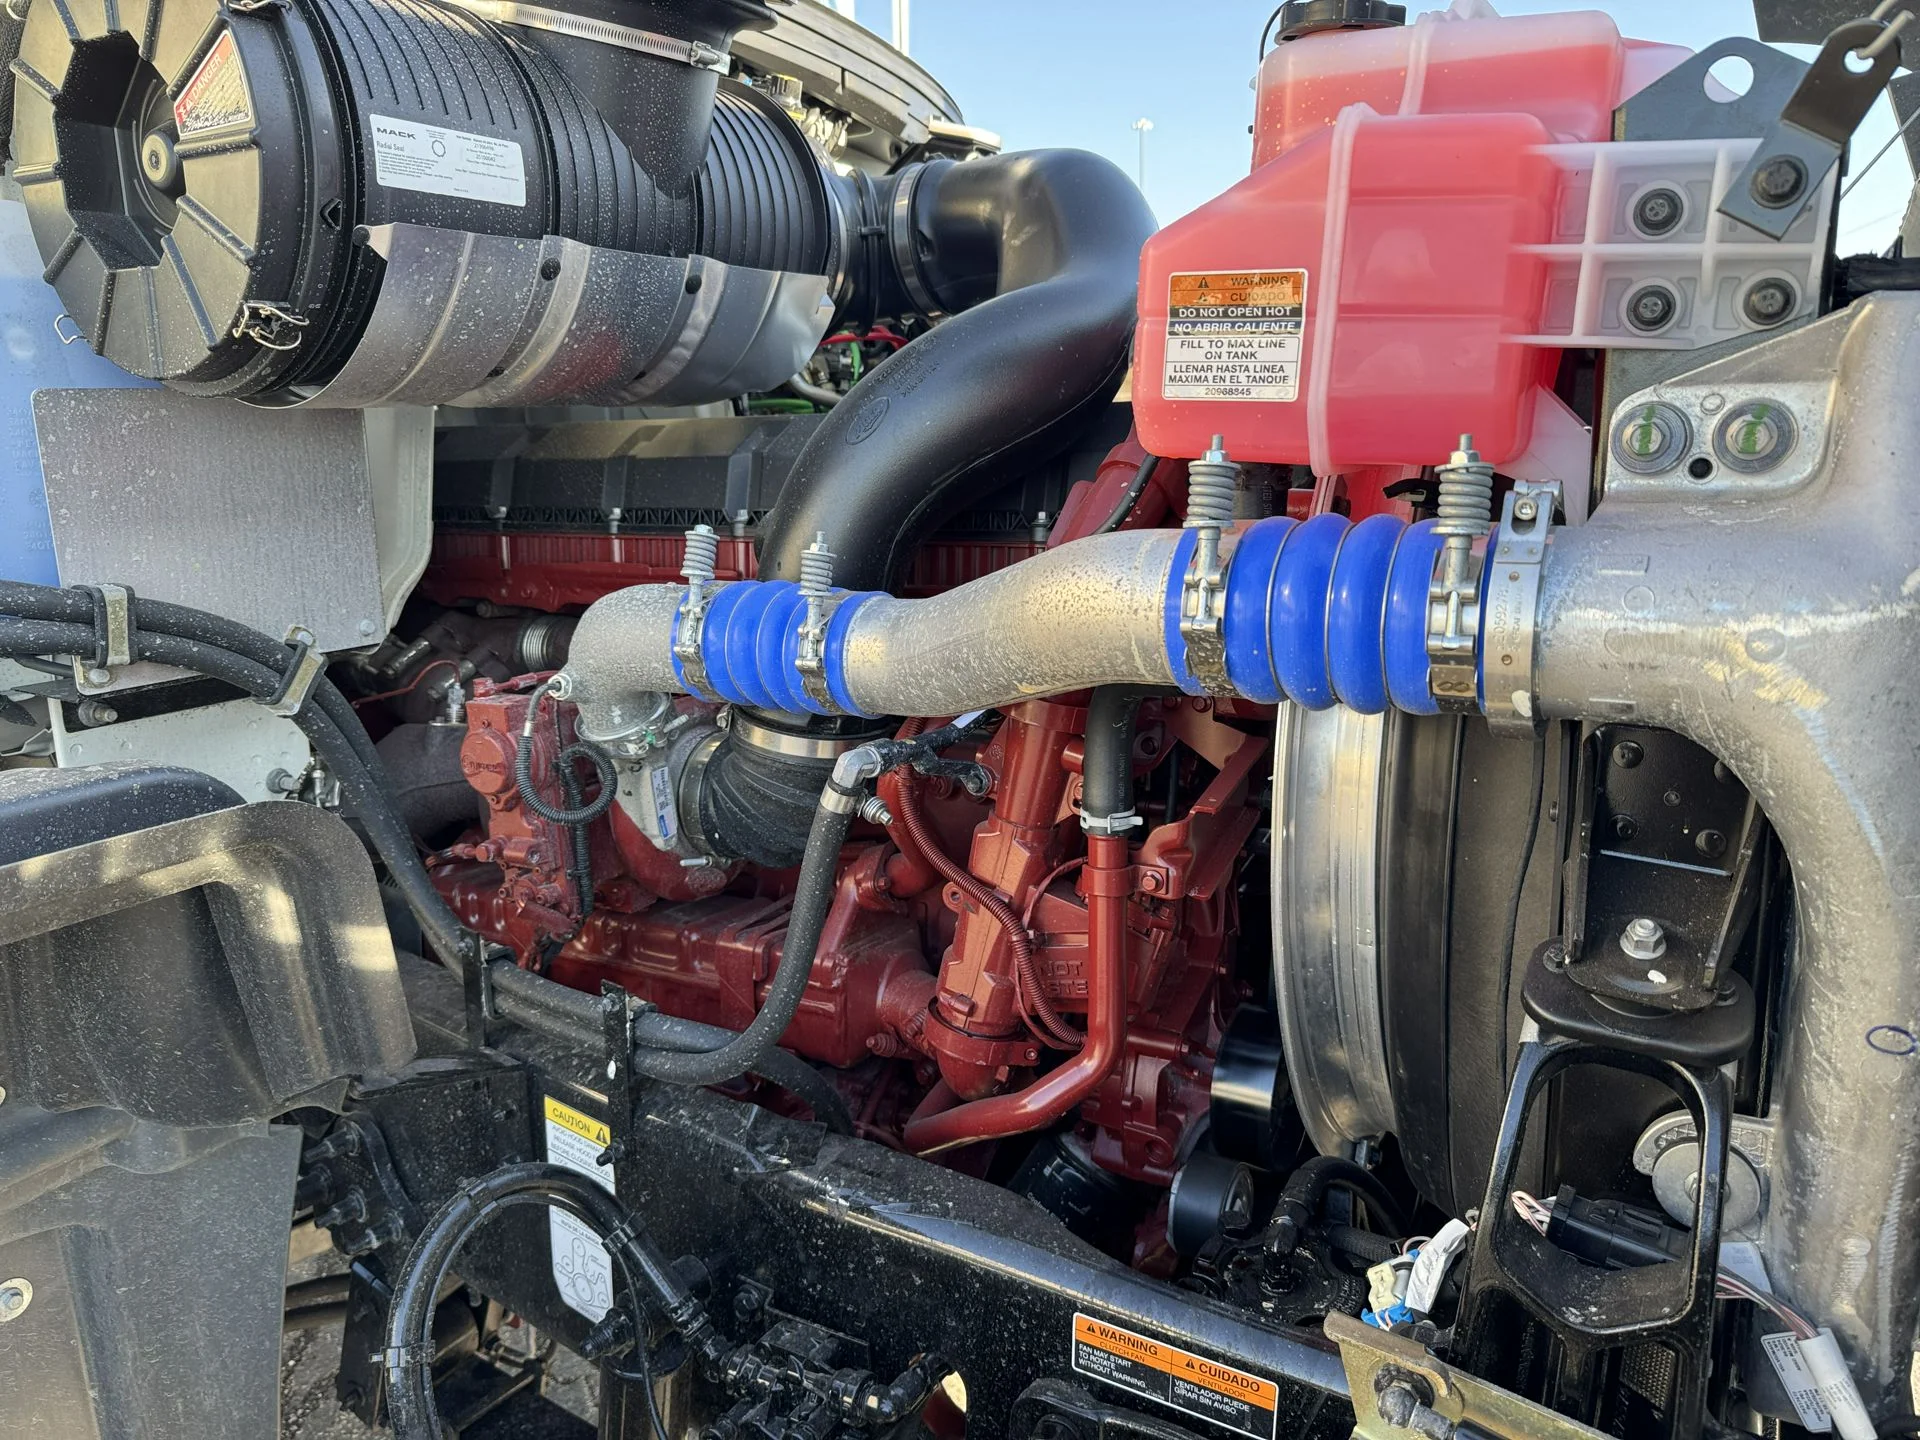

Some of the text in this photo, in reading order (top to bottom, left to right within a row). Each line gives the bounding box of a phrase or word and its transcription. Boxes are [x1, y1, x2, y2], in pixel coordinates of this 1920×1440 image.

[193, 54, 221, 97] DANGER
[377, 128, 416, 140] MACK
[1231, 276, 1289, 286] WARNING
[1230, 291, 1286, 301] CUIDADO
[1179, 306, 1293, 317] DO NOT OPEN HOT
[1174, 322, 1296, 332] NO ABRIR CALIENTE
[1180, 339, 1286, 349] FILL TO MAX LINE
[1204, 351, 1258, 360] ON TANK
[1168, 375, 1289, 384] MAXIMA EN EL TANQUE
[1173, 365, 1285, 373] LLENAR HASTA LINEA
[552, 1107, 591, 1134] CAUTION
[1099, 1326, 1158, 1356] WARNING
[1079, 1343, 1132, 1368] FAN MAY START
[1079, 1350, 1116, 1370] TO ROTATE
[1100, 1341, 1145, 1363] CLUTCH FAN
[1079, 1358, 1148, 1389] WITHOUT WARNING.
[1199, 1363, 1260, 1392] CUIDADO
[1174, 1379, 1222, 1402] VENTILADOR
[1223, 1397, 1251, 1412] PUEDE
[1197, 1376, 1246, 1400] VENTILADOR
[1174, 1387, 1198, 1401] GIRAR
[1199, 1396, 1212, 1406] SIN
[1213, 1401, 1238, 1416] AVISO.
